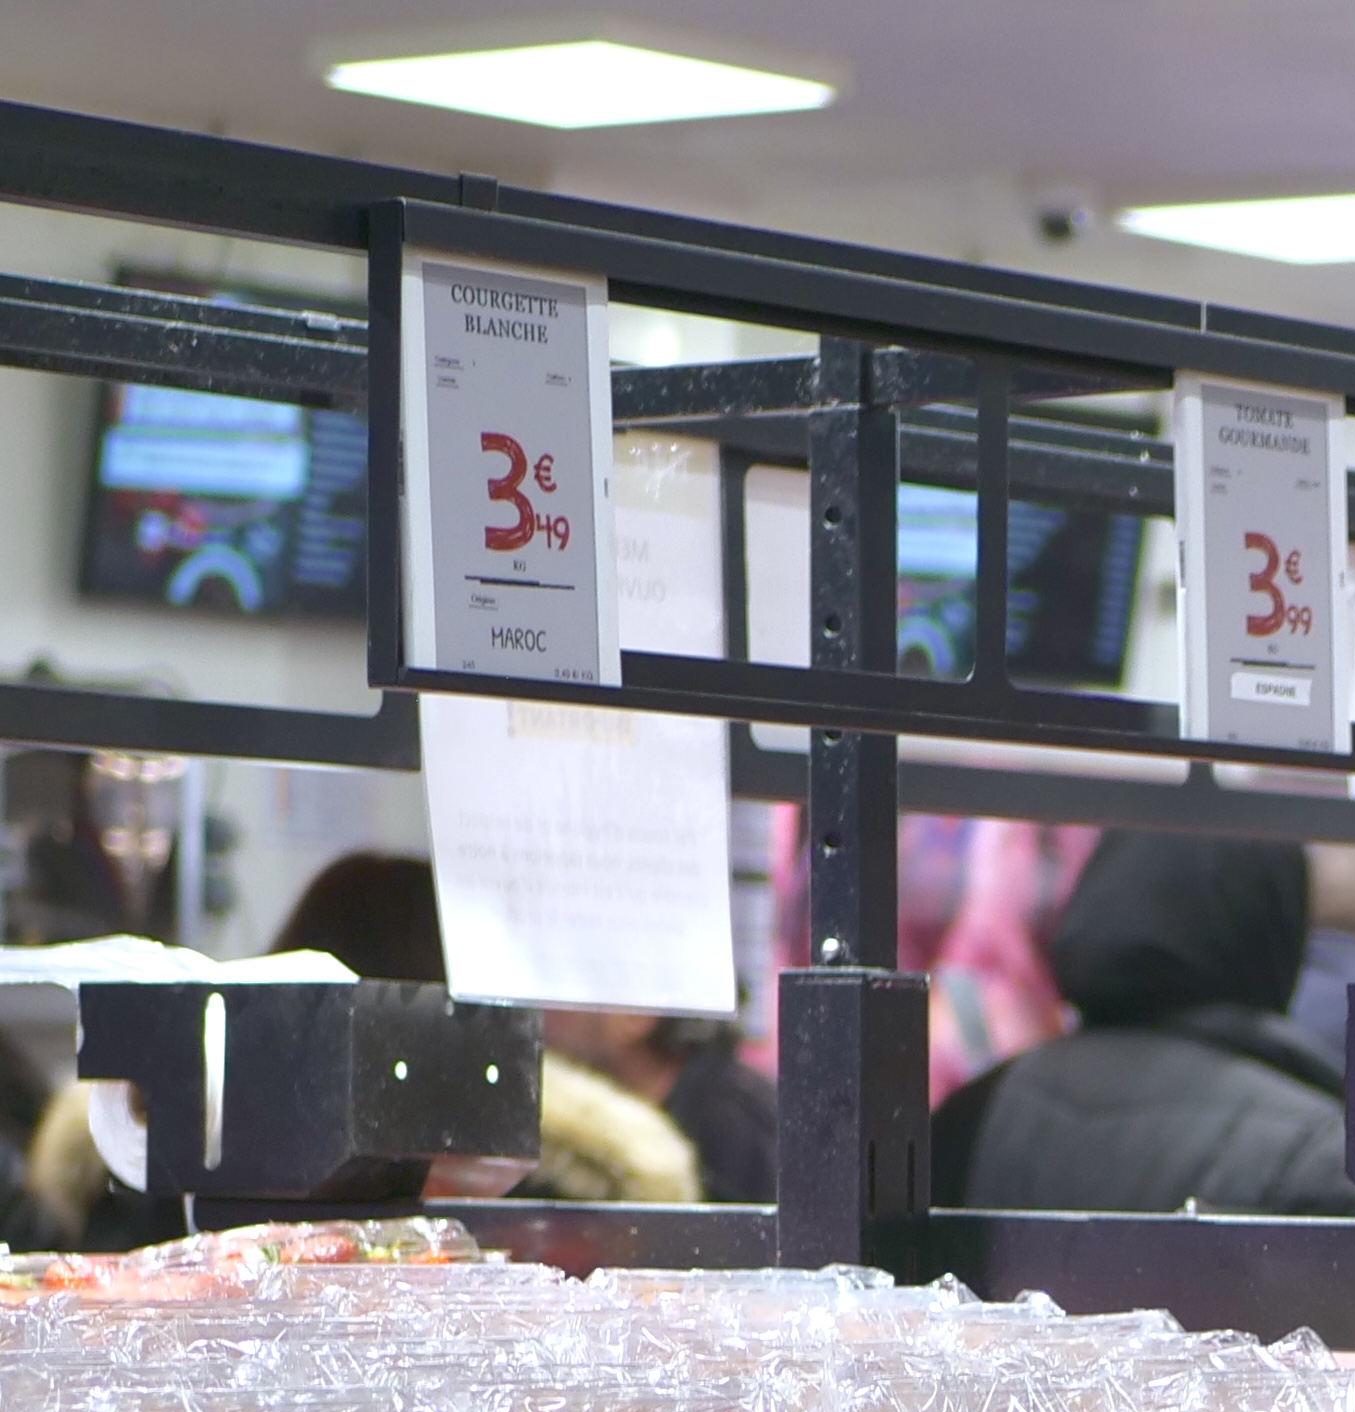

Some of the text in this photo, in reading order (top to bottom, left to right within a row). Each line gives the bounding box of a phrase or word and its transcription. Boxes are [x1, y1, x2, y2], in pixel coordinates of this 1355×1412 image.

[451, 283, 559, 318] COURGETTE
[464, 313, 549, 344] BLANCHE
[1232, 402, 1295, 429] TOMATE
[1218, 424, 1313, 455] GOURMANDE
[491, 627, 548, 653] MAROC
